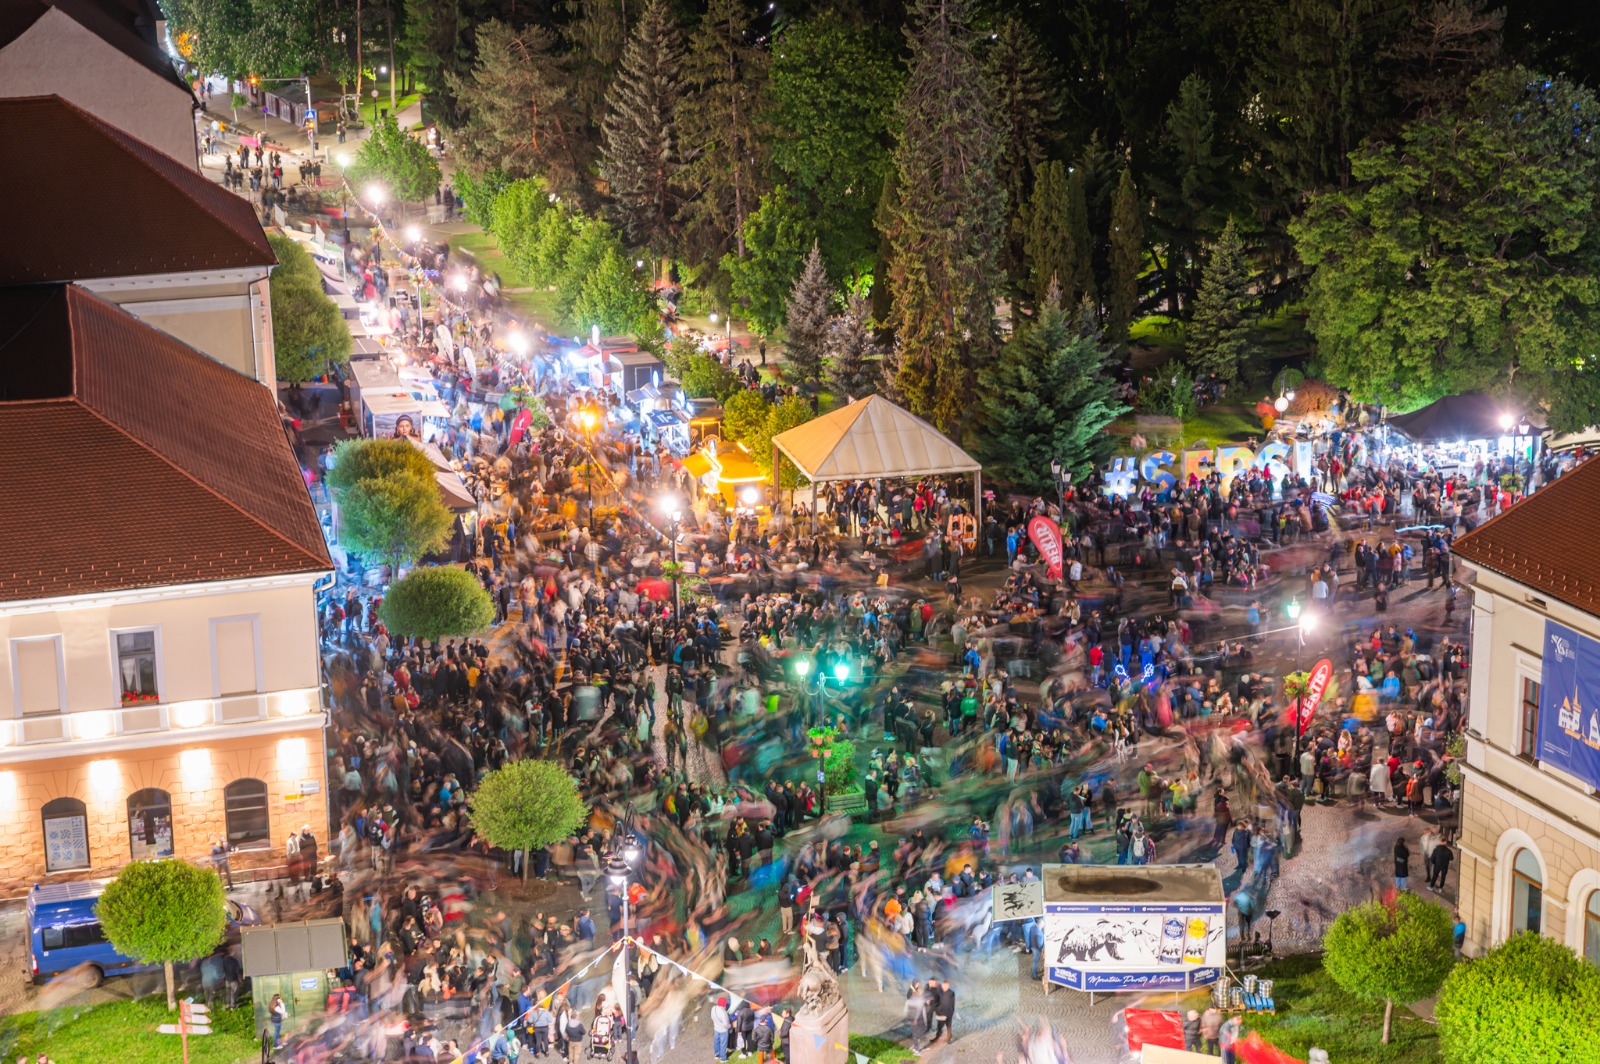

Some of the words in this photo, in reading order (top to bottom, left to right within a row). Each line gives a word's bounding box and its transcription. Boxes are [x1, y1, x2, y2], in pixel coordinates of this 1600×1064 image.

[1088, 975, 1122, 987] Mountain
[1123, 975, 1148, 987] Purity
[1149, 974, 1157, 984] &
[1159, 975, 1184, 984] Power
